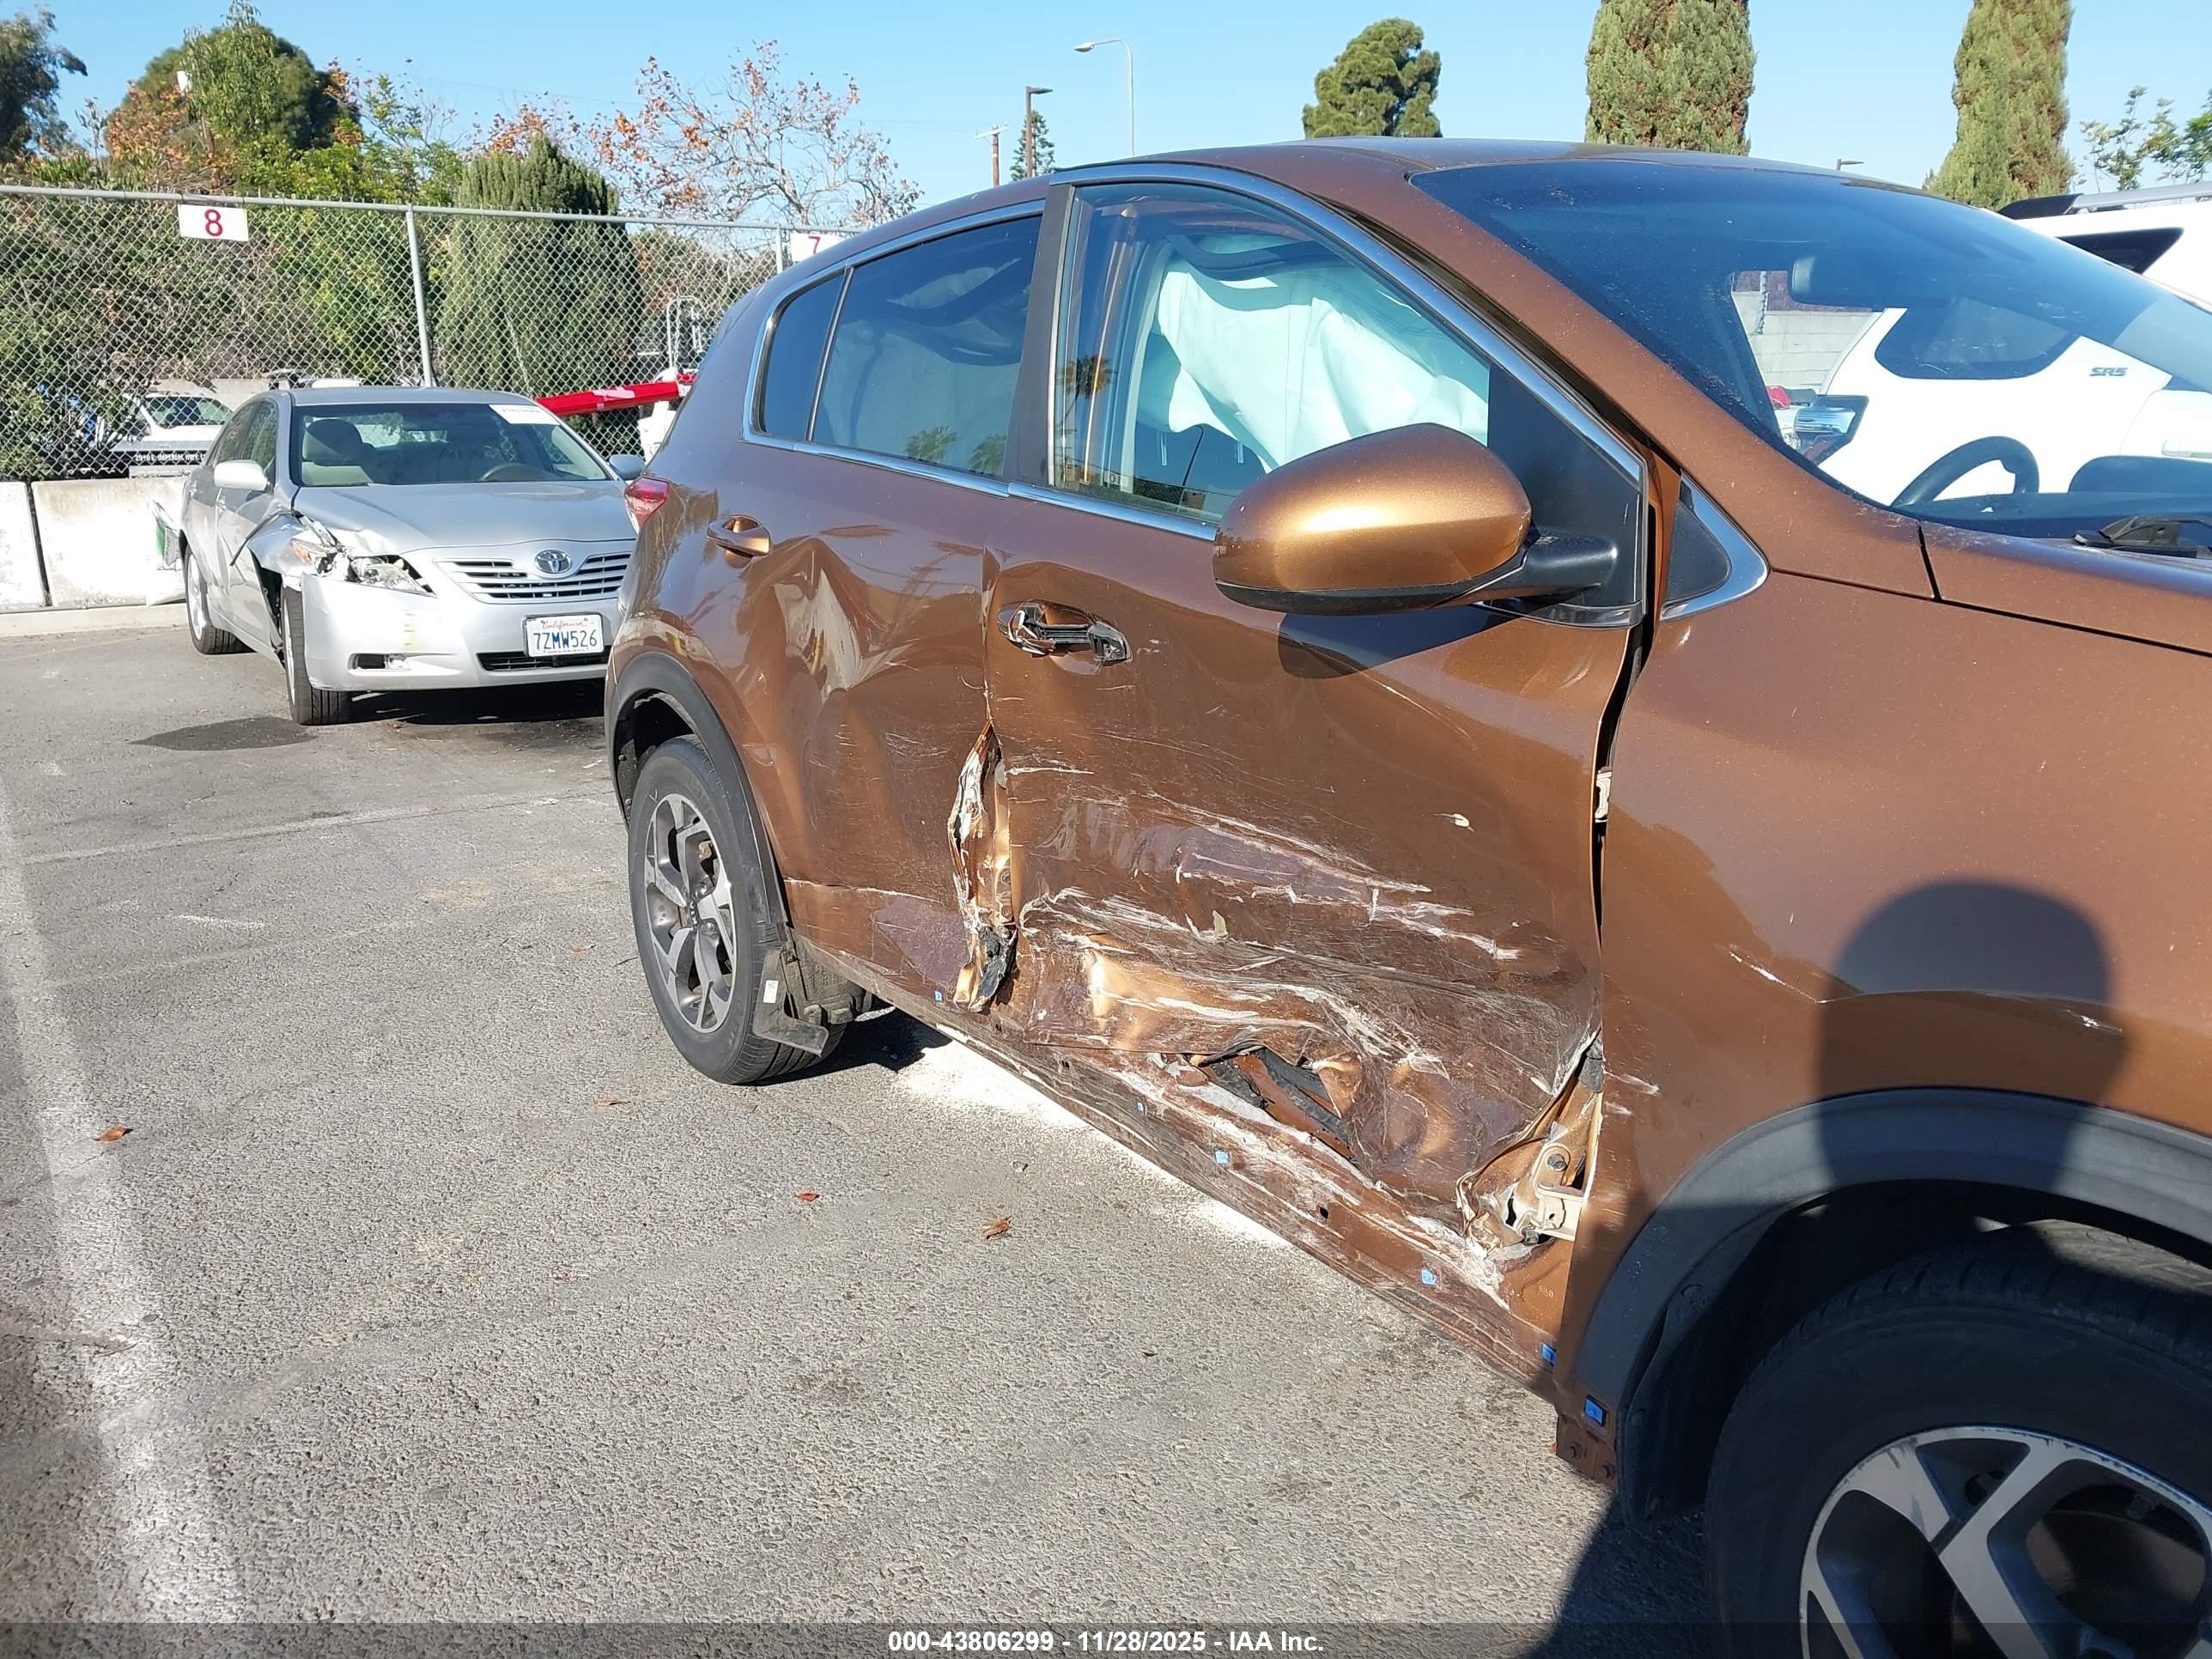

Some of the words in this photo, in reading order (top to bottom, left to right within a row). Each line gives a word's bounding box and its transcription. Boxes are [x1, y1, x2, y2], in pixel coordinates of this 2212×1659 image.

[204, 209, 223, 236] 8
[808, 235, 821, 254] 7
[2089, 367, 2129, 377] SR5
[532, 629, 598, 650] 7ZMW526
